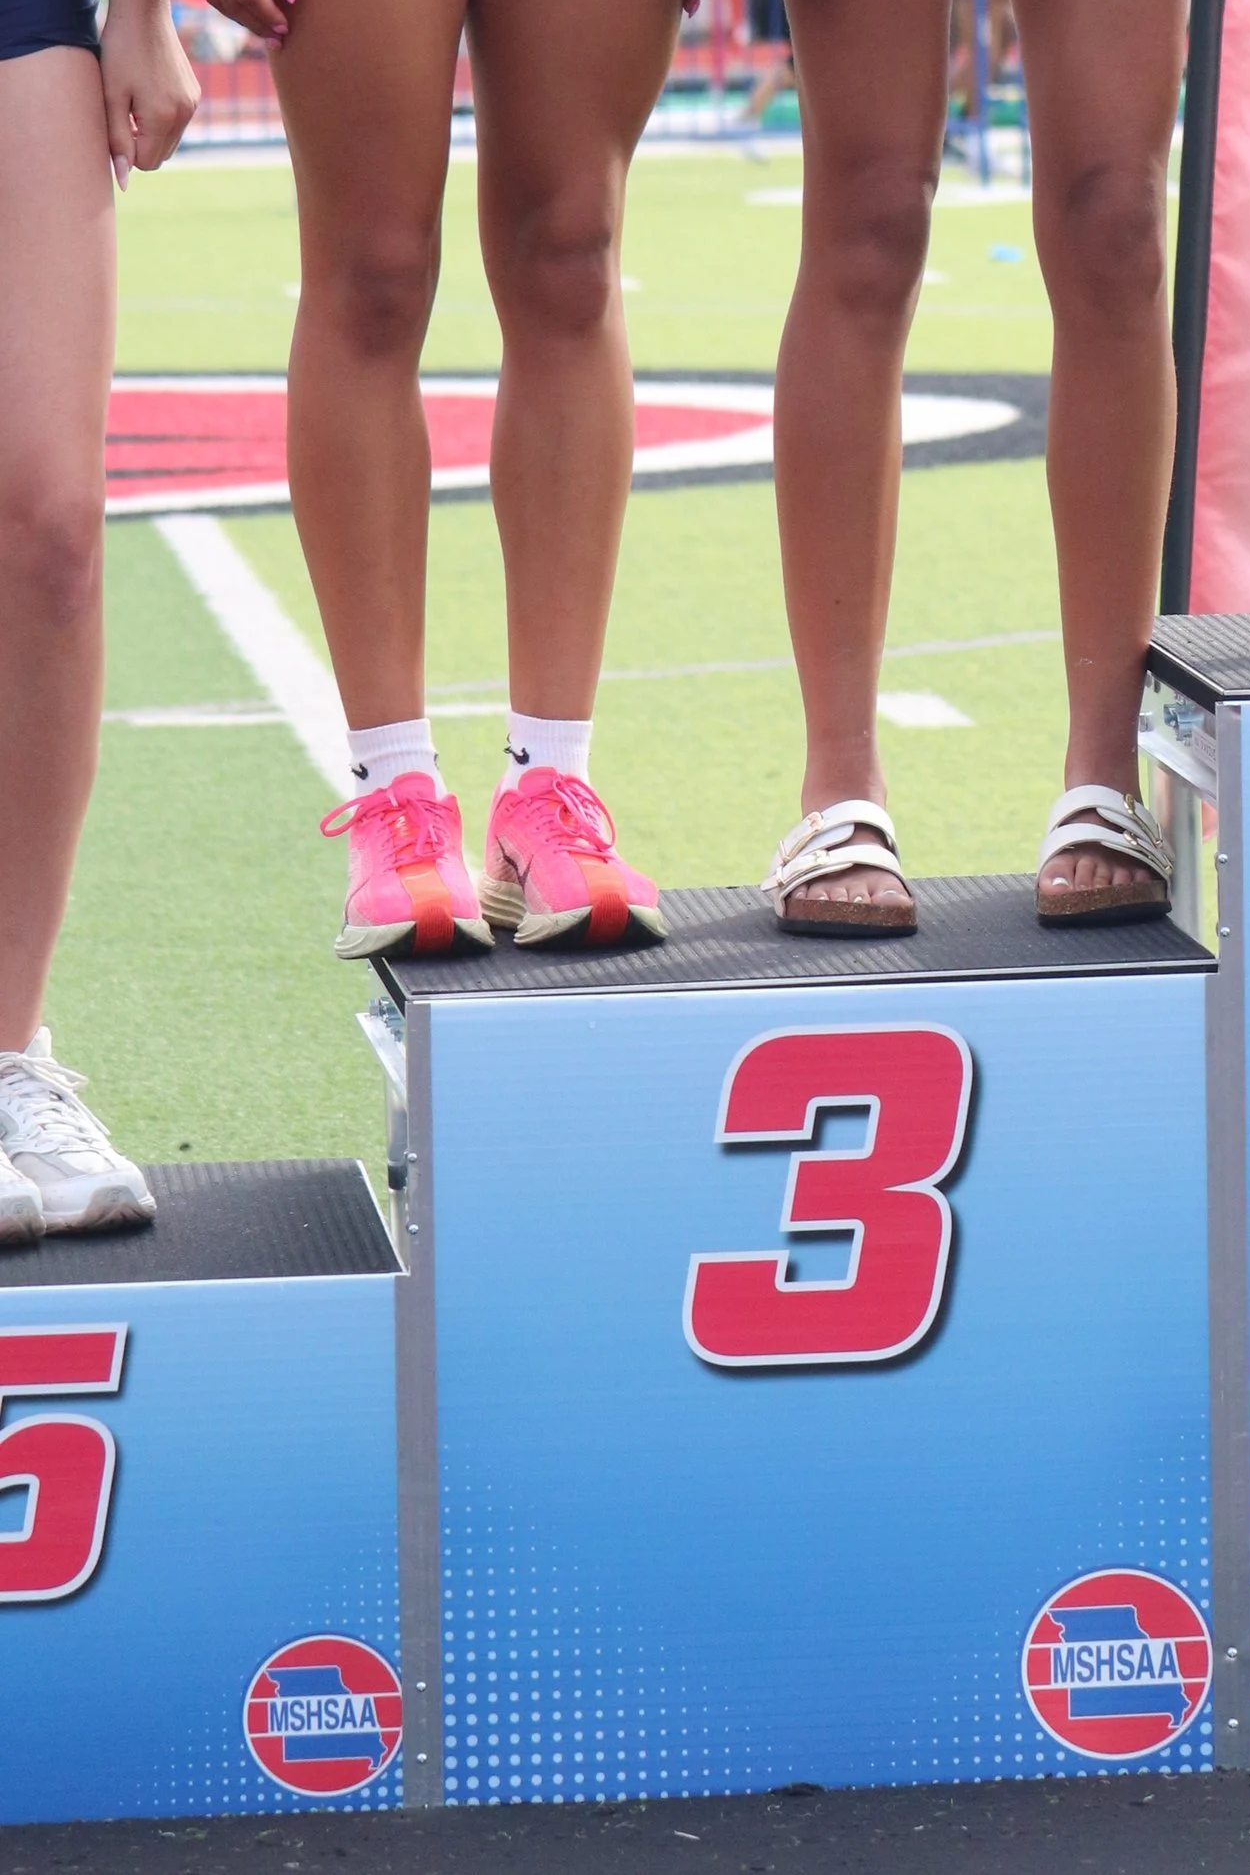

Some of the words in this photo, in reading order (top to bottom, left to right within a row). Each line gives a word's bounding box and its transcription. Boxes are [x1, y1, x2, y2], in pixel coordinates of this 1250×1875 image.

[682, 1020, 973, 1367] 3
[0, 1322, 128, 1603] 5
[268, 1696, 378, 1735] MSHSAA
[1051, 1642, 1179, 1685] MSHSAA
